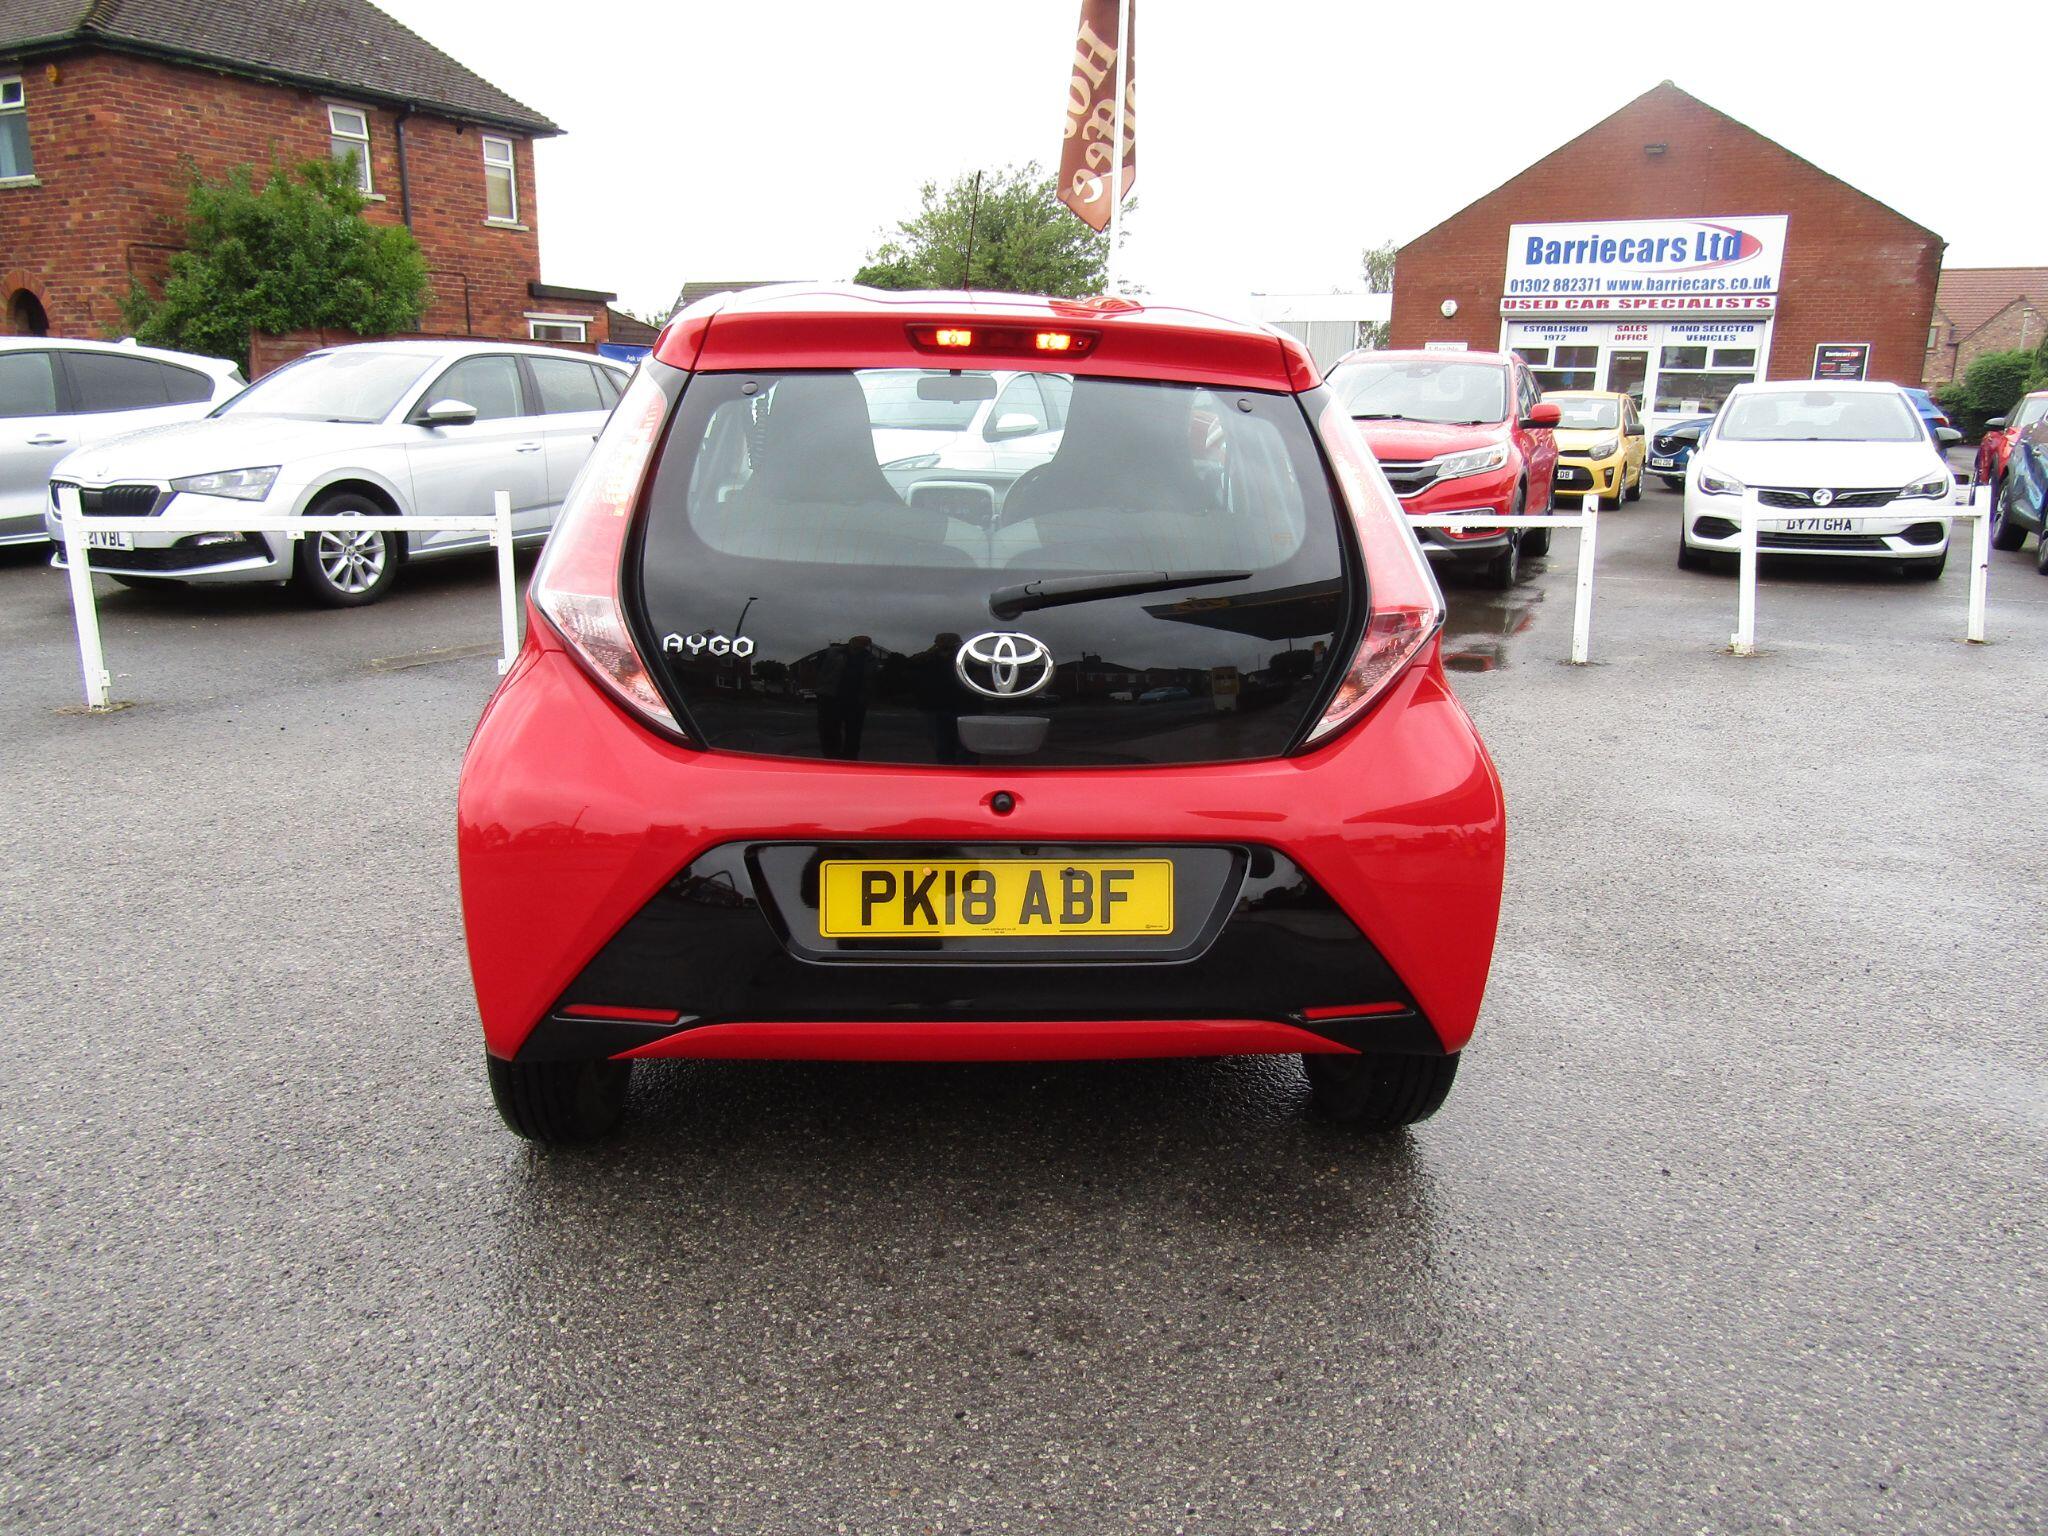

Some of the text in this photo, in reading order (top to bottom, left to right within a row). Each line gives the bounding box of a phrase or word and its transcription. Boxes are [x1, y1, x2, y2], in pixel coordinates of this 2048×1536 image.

[1525, 230, 1743, 265] Barriecars Ltd
[1510, 275, 1772, 293] 01302 882371 www.barriecars.co.uk
[1503, 297, 1771, 310] USED CAR SPECIALISTS
[1523, 325, 1589, 333] ESTABLISHED
[1702, 324, 1755, 332] SELECTED
[1823, 518, 1853, 531] GHA
[663, 633, 754, 658] AYGO
[861, 869, 1135, 926] PK18 ABF
